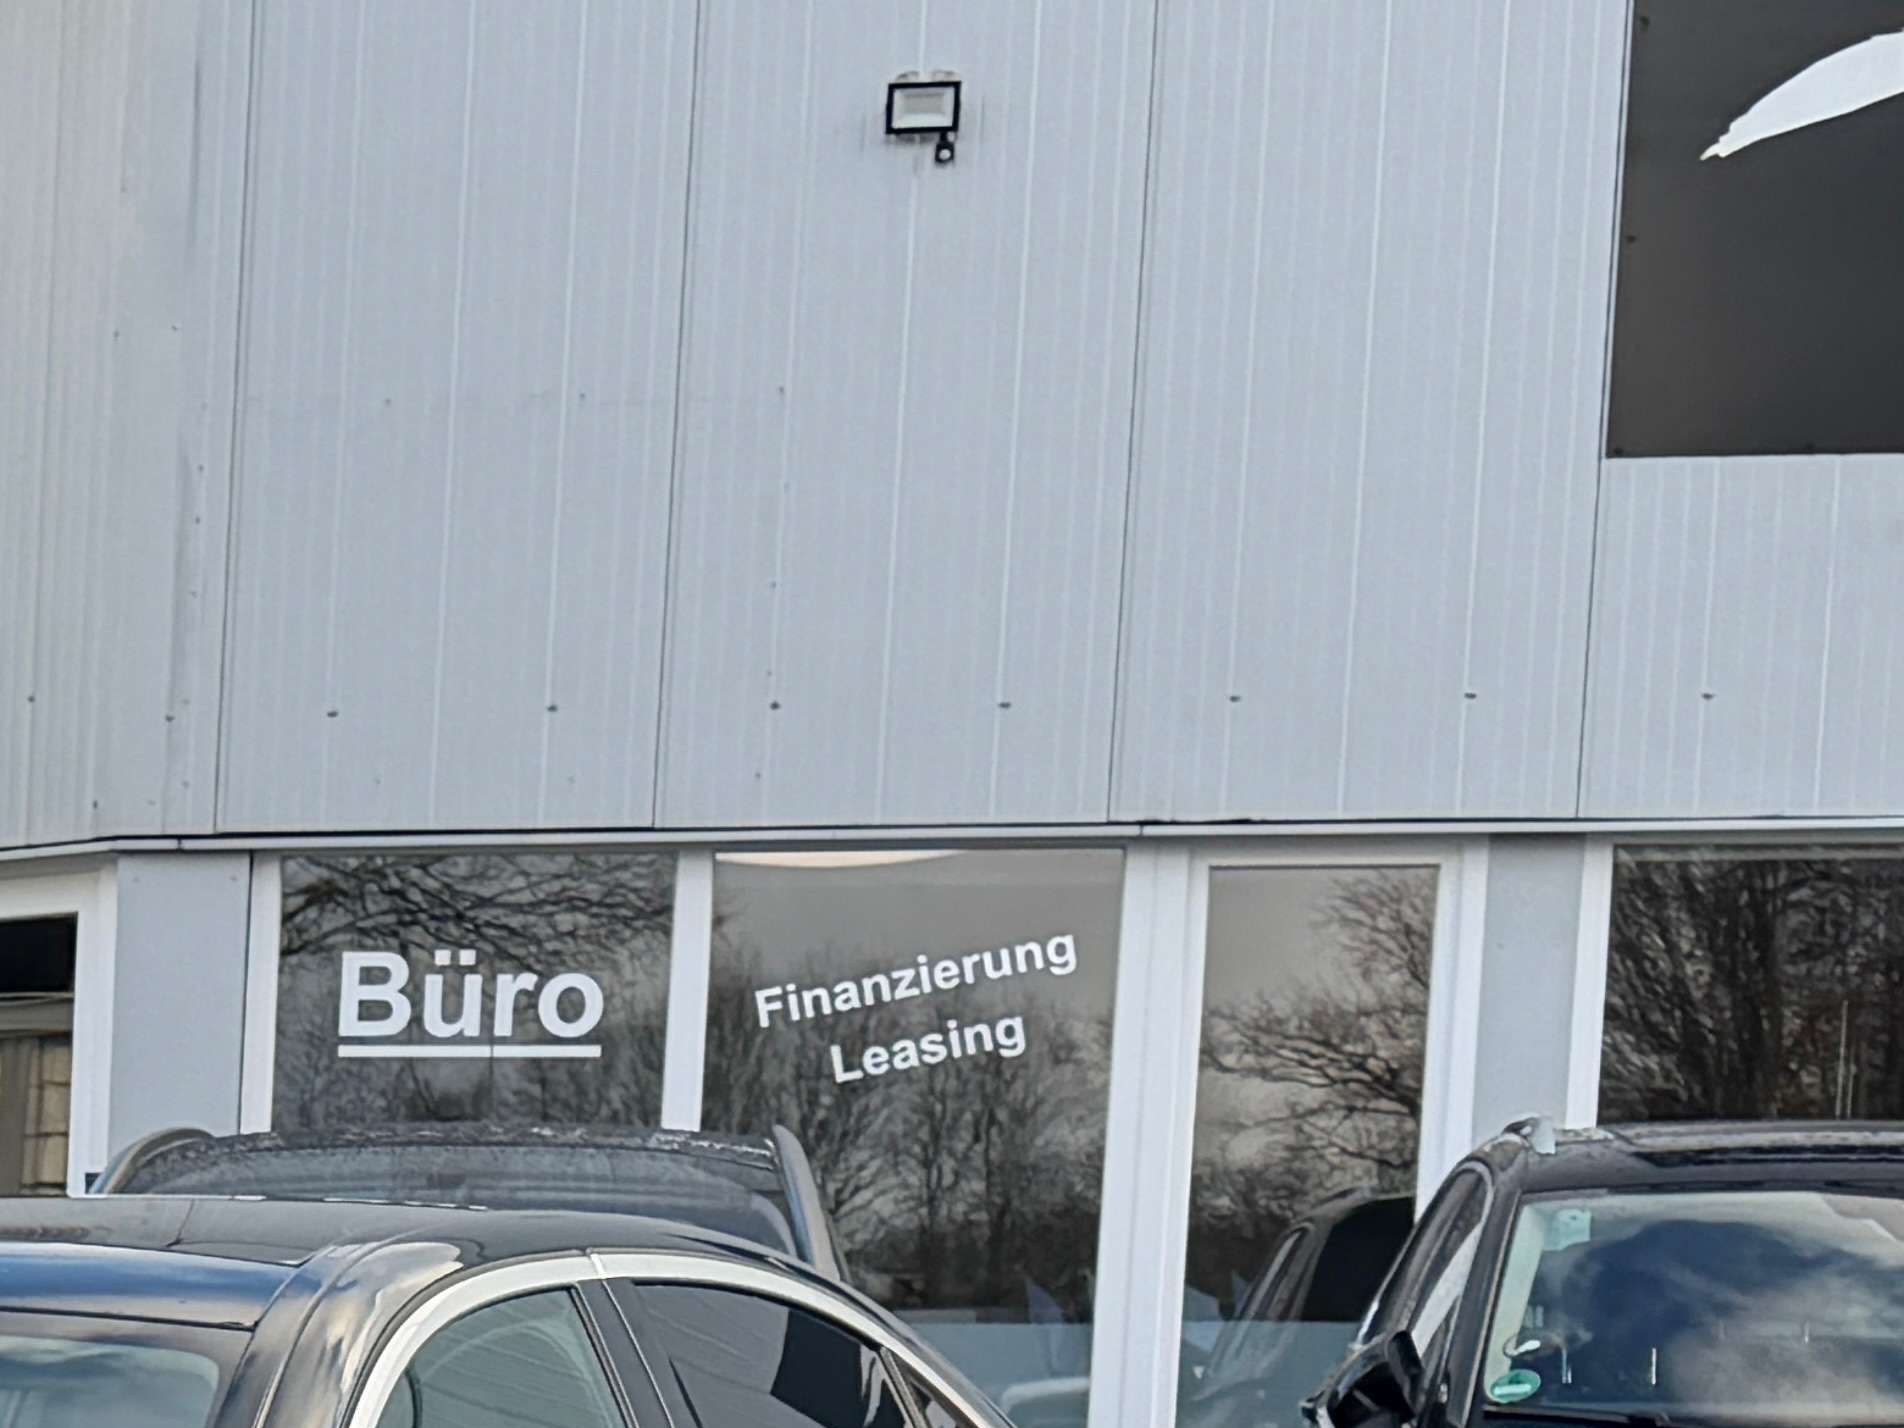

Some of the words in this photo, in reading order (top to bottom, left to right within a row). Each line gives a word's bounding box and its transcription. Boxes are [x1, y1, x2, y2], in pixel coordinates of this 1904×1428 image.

[338, 949, 604, 1038] Büro
[754, 934, 1078, 1028] Finanzierung
[830, 1016, 1027, 1084] Leasing
